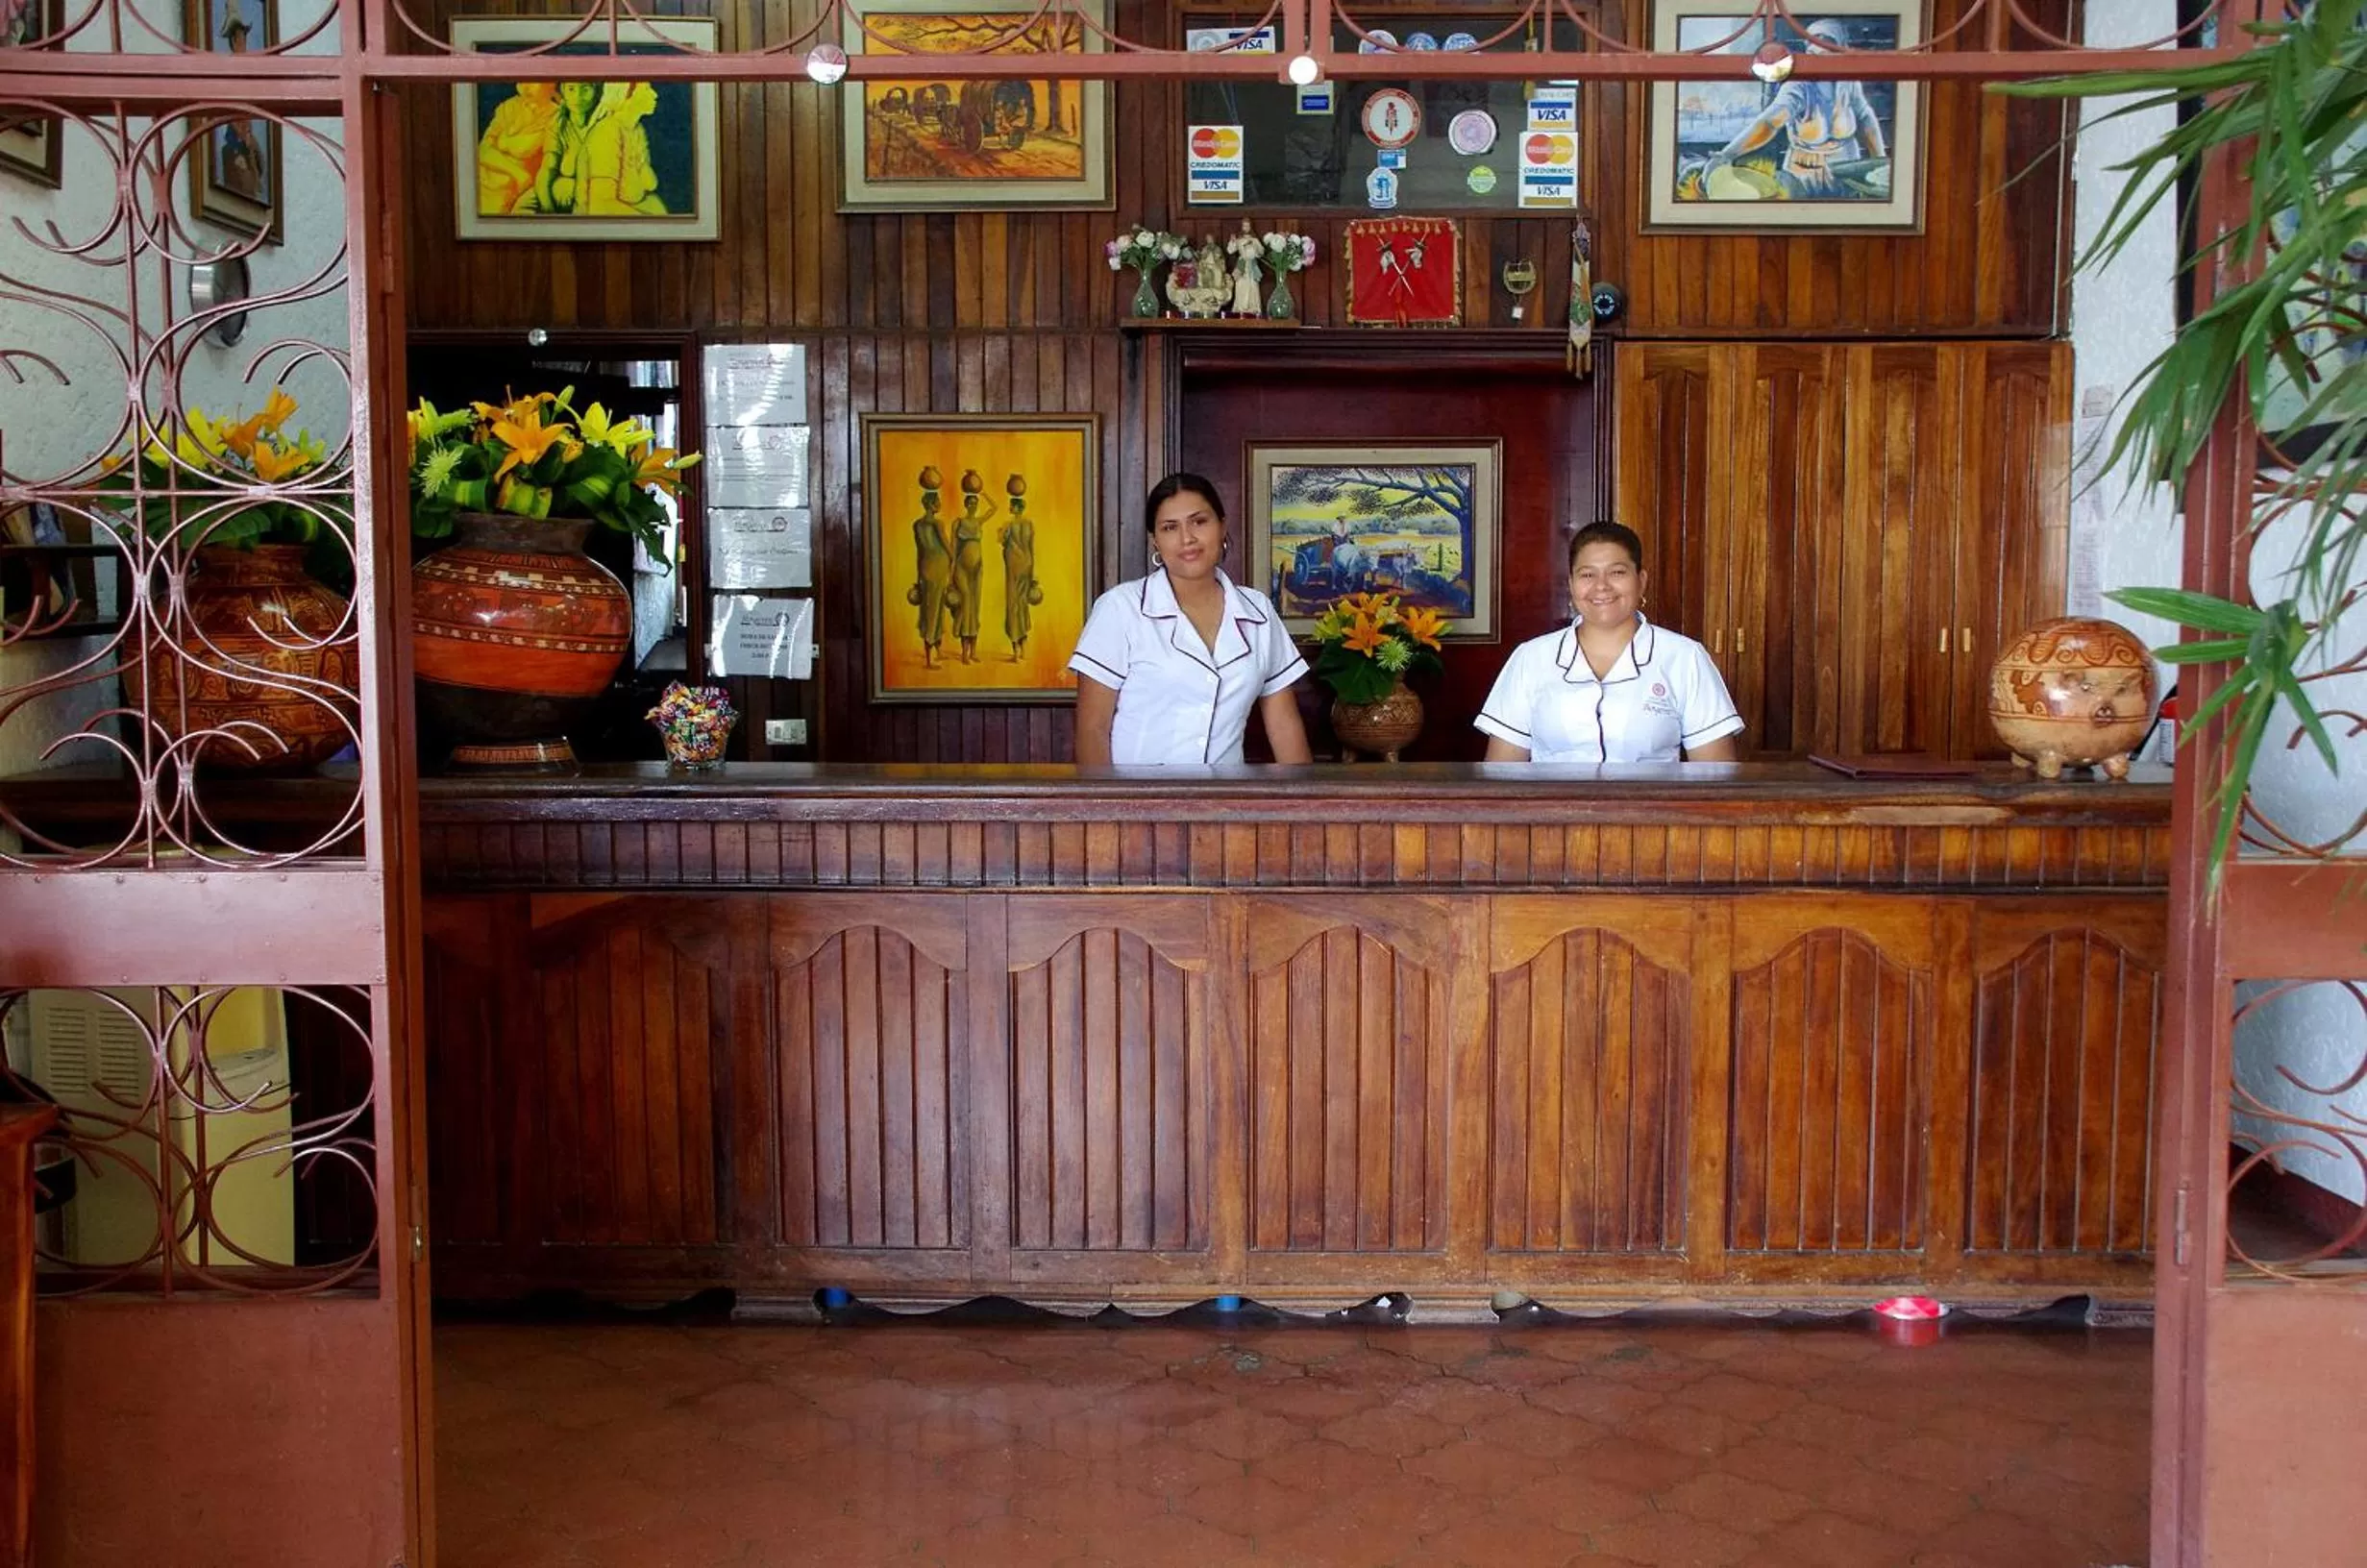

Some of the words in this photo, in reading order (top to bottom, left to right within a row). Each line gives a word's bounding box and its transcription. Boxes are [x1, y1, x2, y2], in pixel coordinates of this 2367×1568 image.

[1235, 38, 1264, 50] VISA
[1537, 110, 1566, 120] VISA
[1204, 181, 1227, 189] VISA
[1538, 185, 1561, 195] VISA
